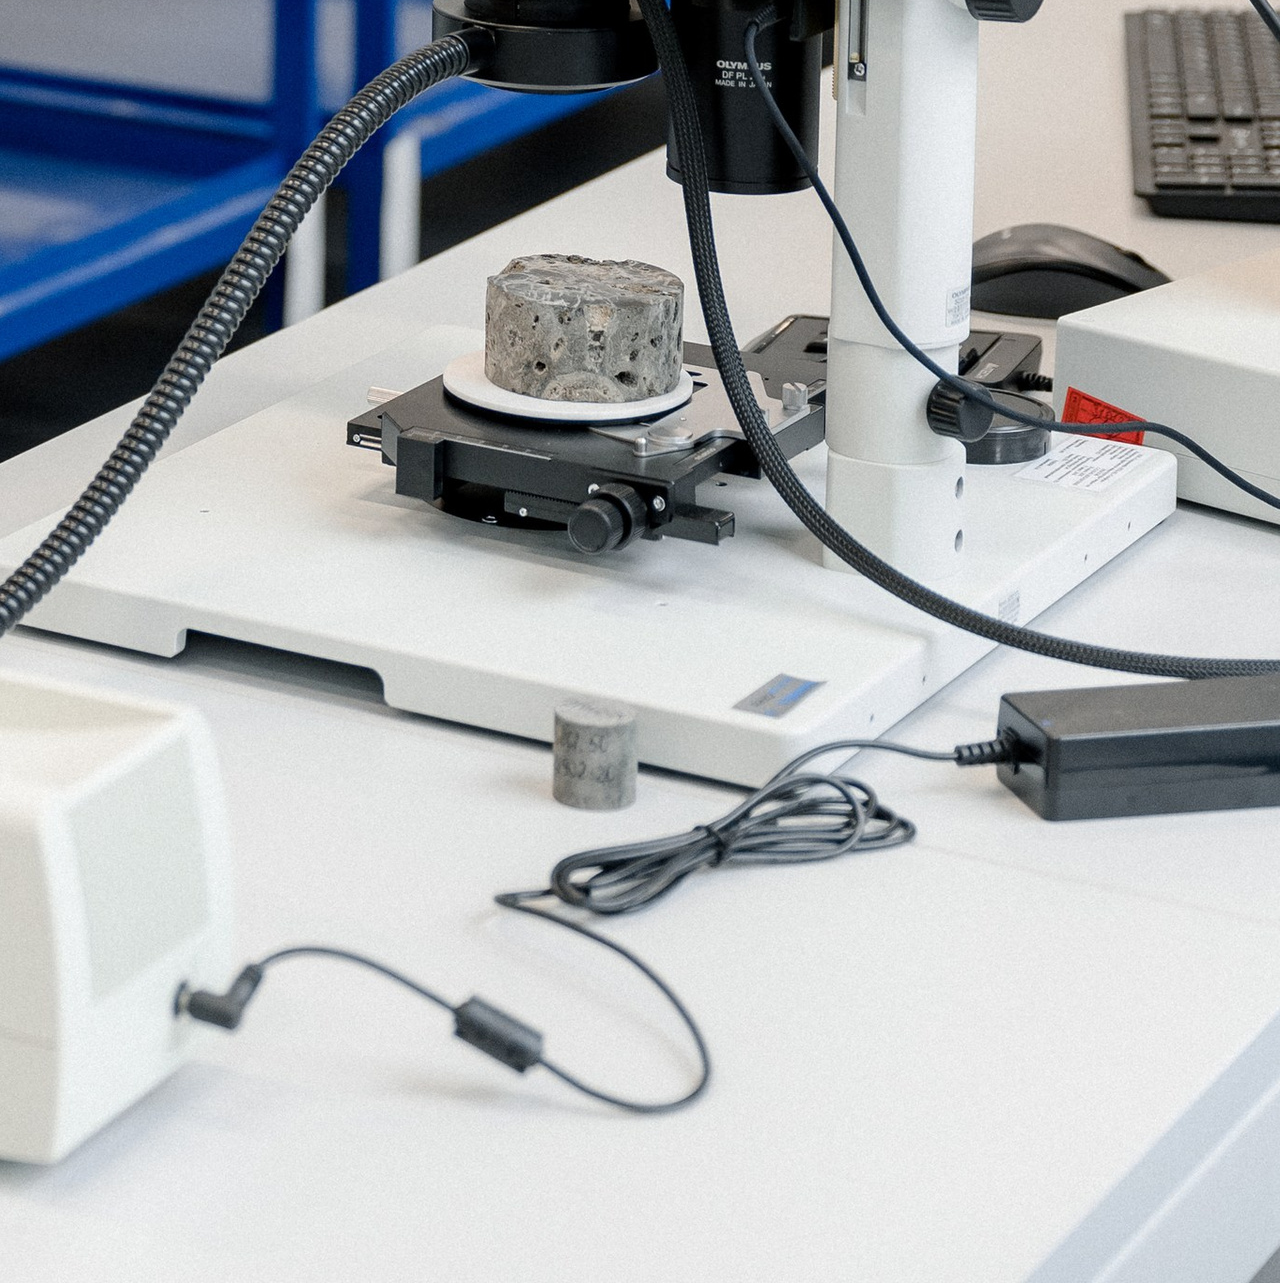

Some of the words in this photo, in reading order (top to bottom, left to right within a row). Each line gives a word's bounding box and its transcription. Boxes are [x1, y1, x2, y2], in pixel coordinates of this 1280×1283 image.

[716, 60, 772, 70] OLYMUS
[722, 71, 734, 79] DF
[715, 79, 736, 87] MADE
